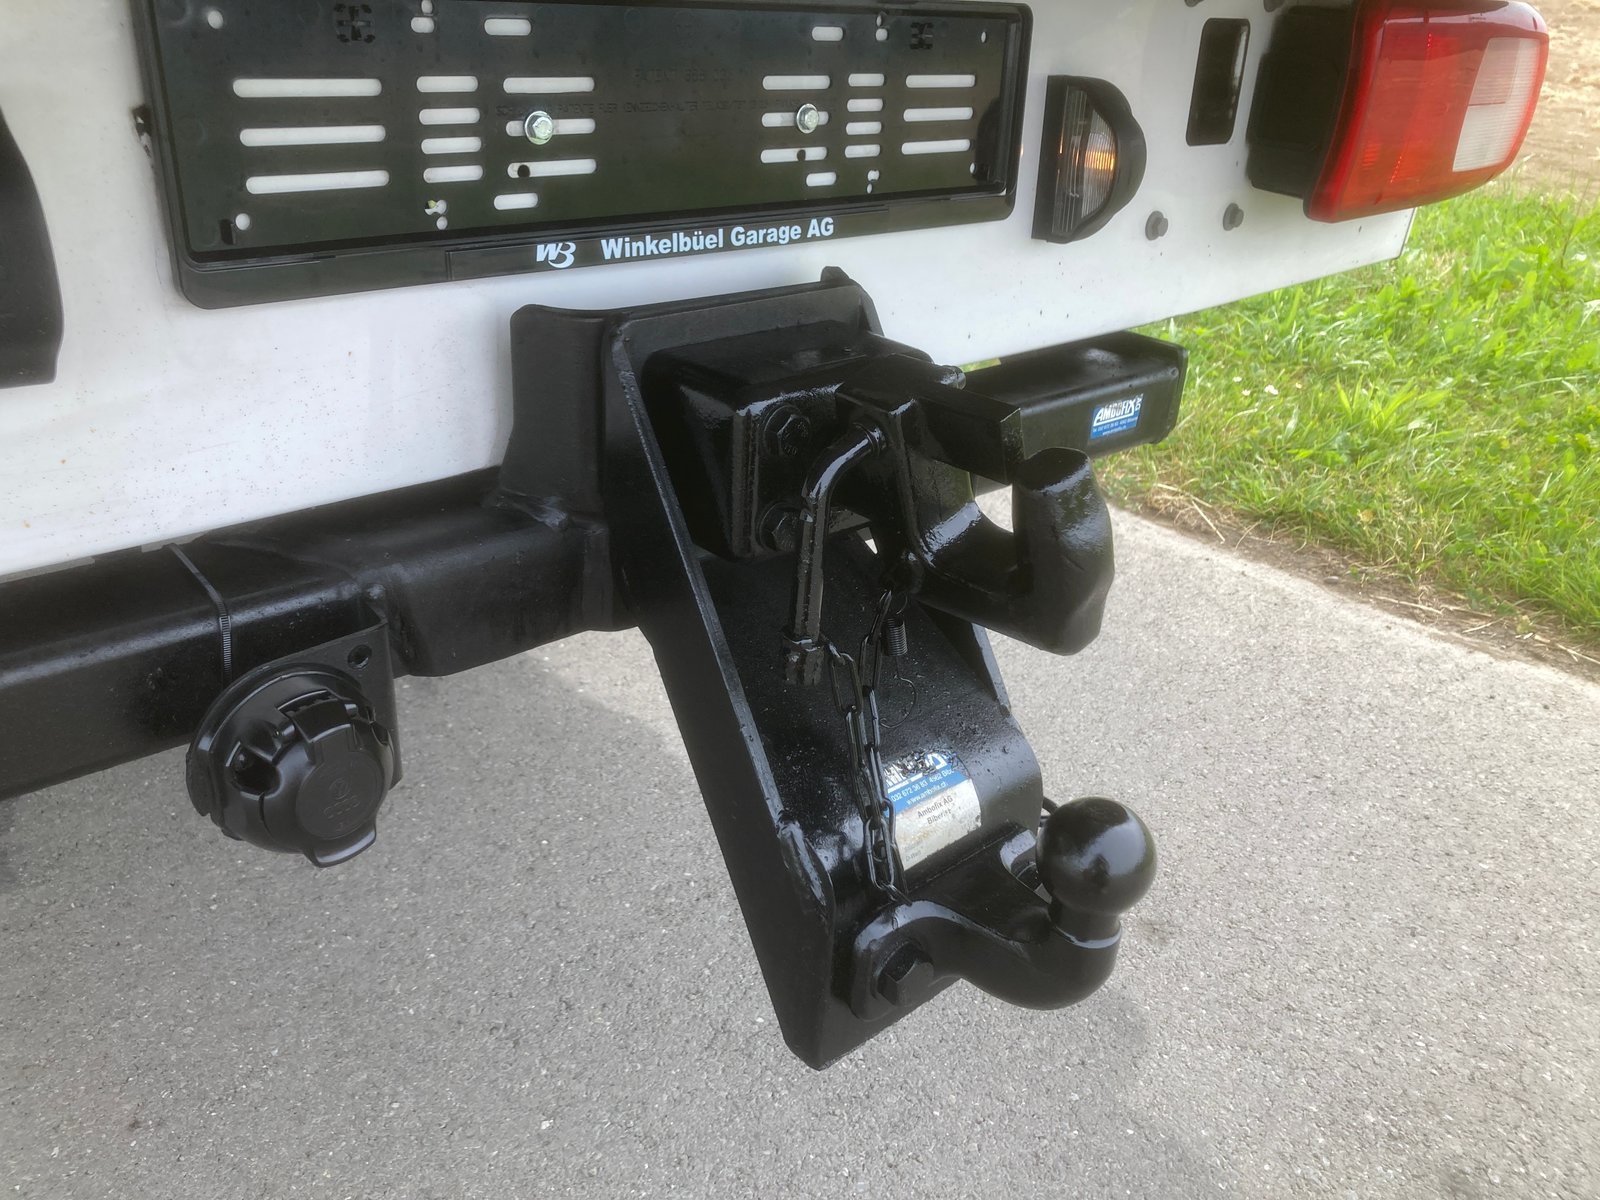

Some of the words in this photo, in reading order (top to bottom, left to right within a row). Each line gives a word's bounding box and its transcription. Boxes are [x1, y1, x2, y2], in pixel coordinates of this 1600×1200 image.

[601, 228, 725, 260] Winkelbüel
[730, 223, 801, 246] Garage
[807, 217, 835, 238] AG
[916, 801, 944, 818] Ambofix
[943, 795, 954, 805] AG
[927, 808, 952, 825] Biberist
